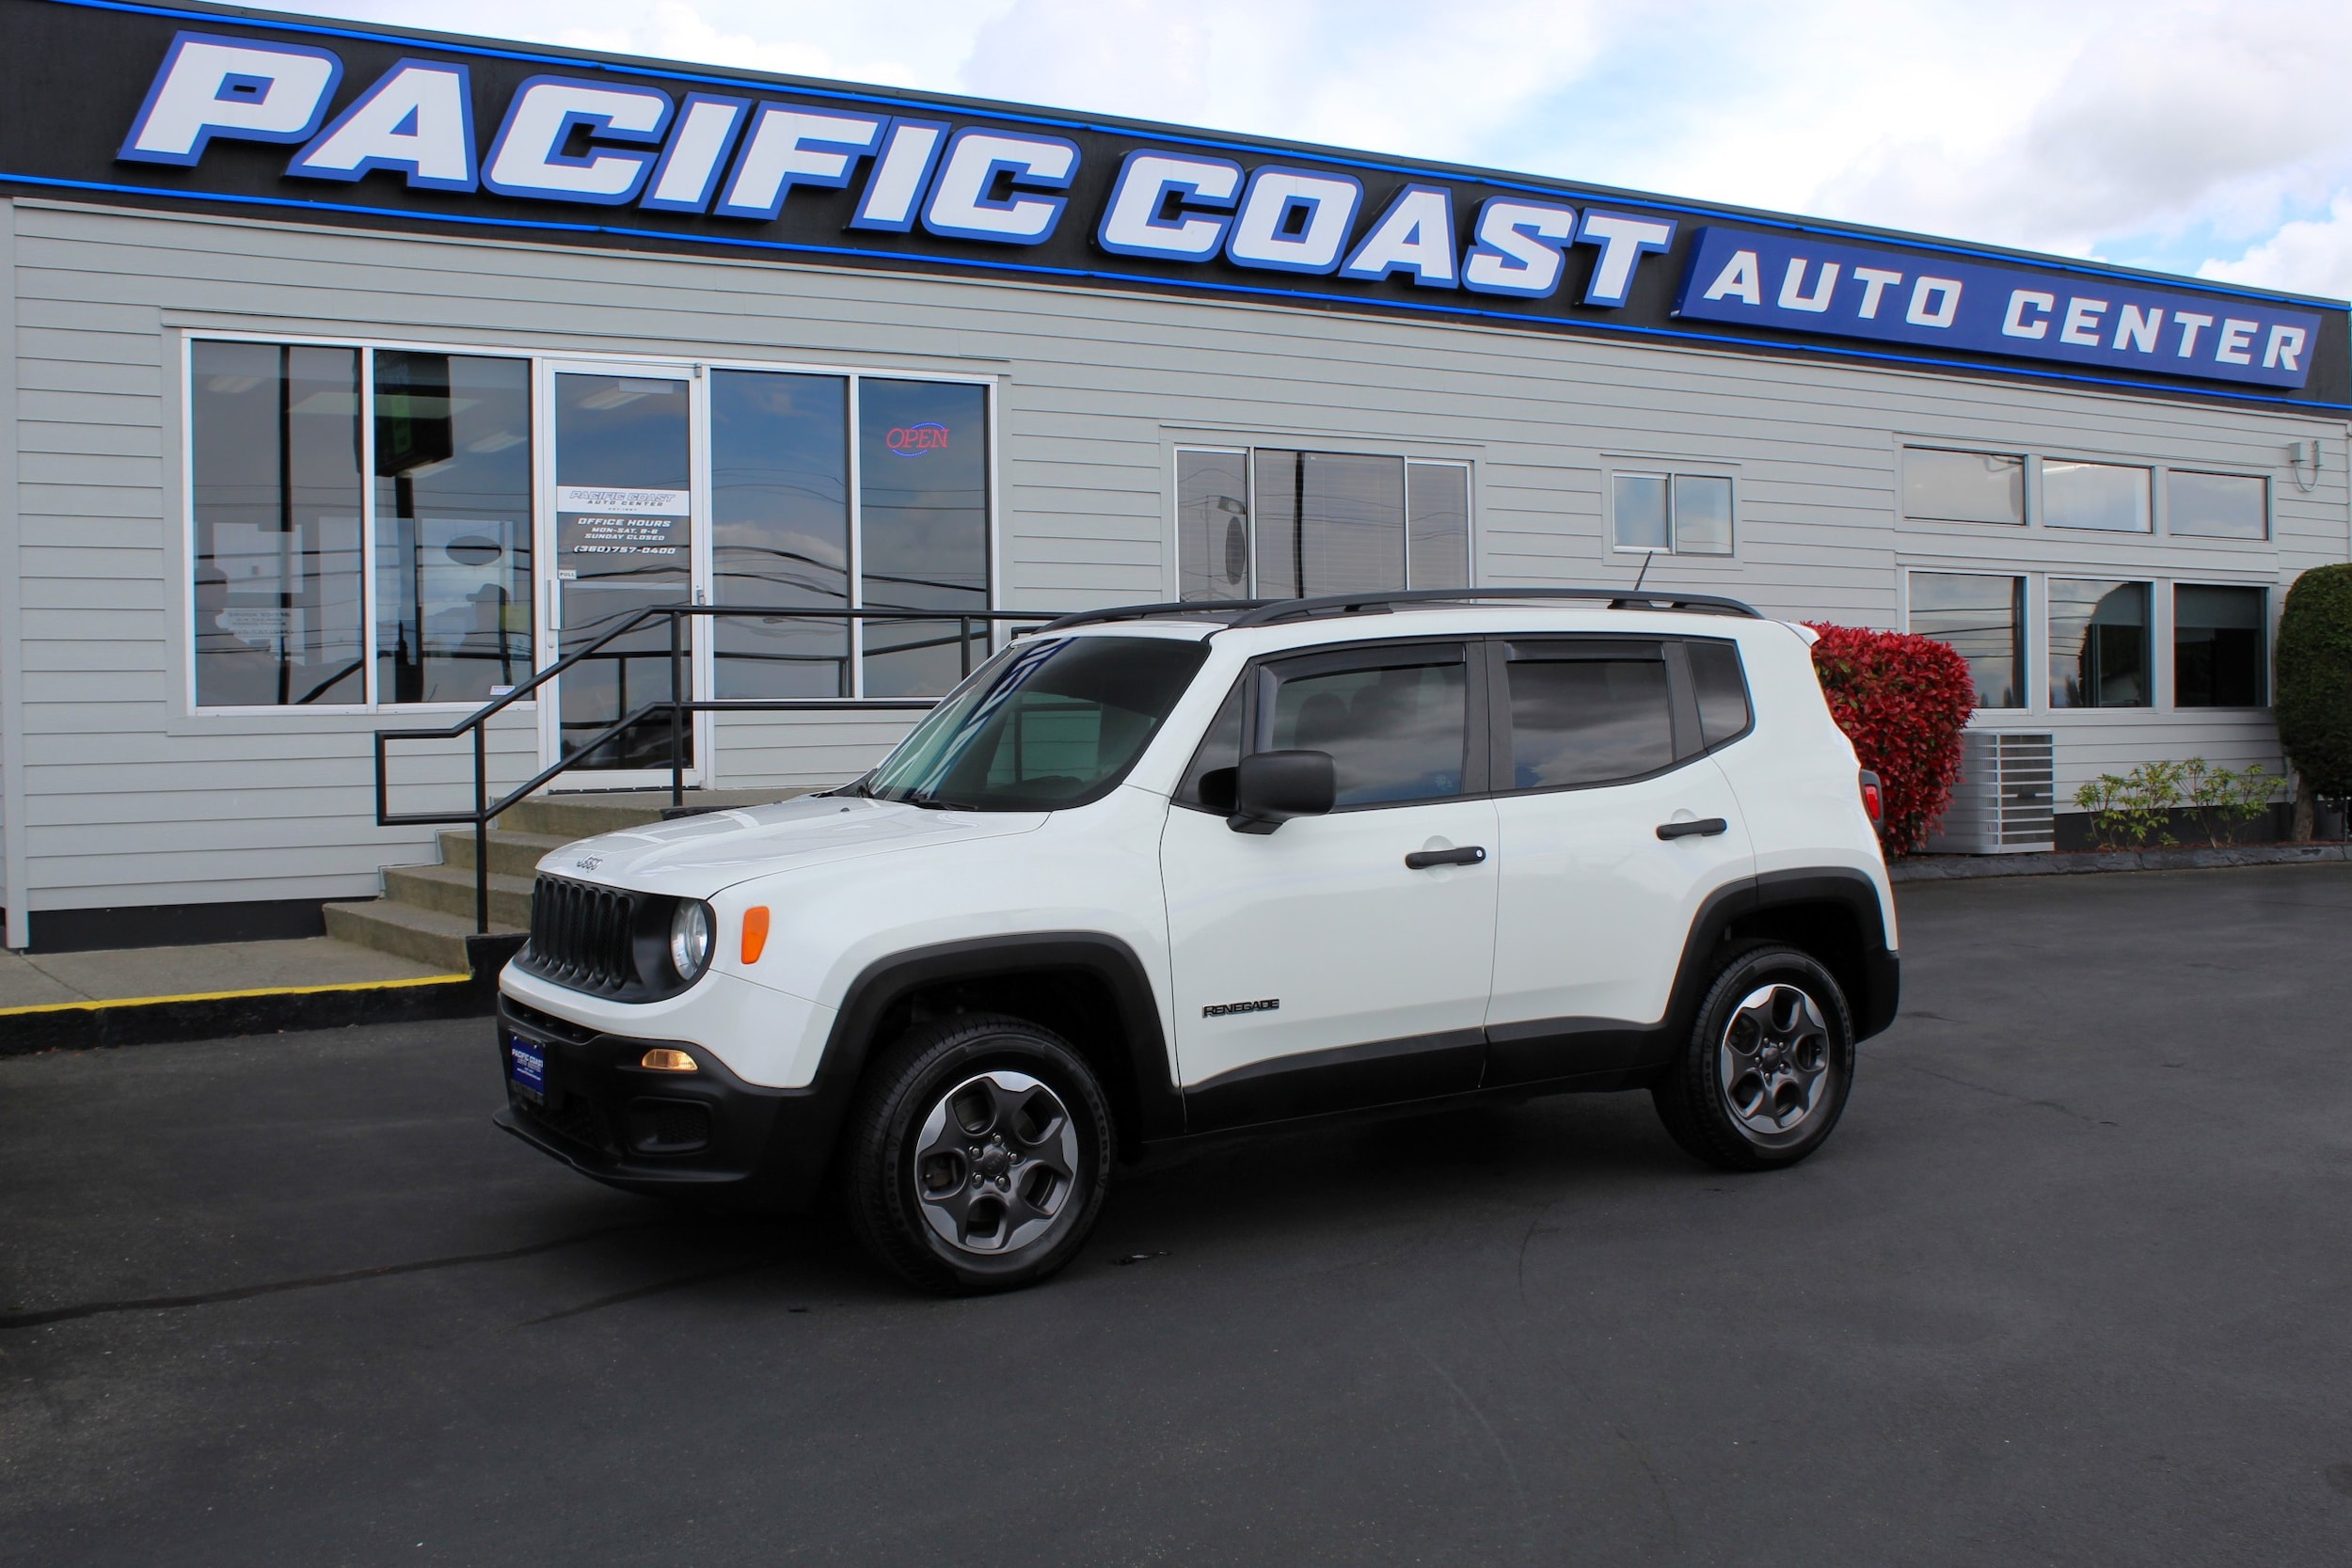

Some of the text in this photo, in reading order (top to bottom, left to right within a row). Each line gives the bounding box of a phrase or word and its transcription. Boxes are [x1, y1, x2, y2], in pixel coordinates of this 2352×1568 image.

[115, 31, 1678, 308] PACIFIC COAST
[1703, 251, 2306, 371] AUTO CENTER
[885, 428, 949, 449] OPEN
[569, 491, 676, 503] PACIFIC COAST
[578, 517, 672, 528] OFFICE HOURS
[573, 546, 676, 555] (360)757-0400
[1202, 998, 1280, 1019] RENEGADE
